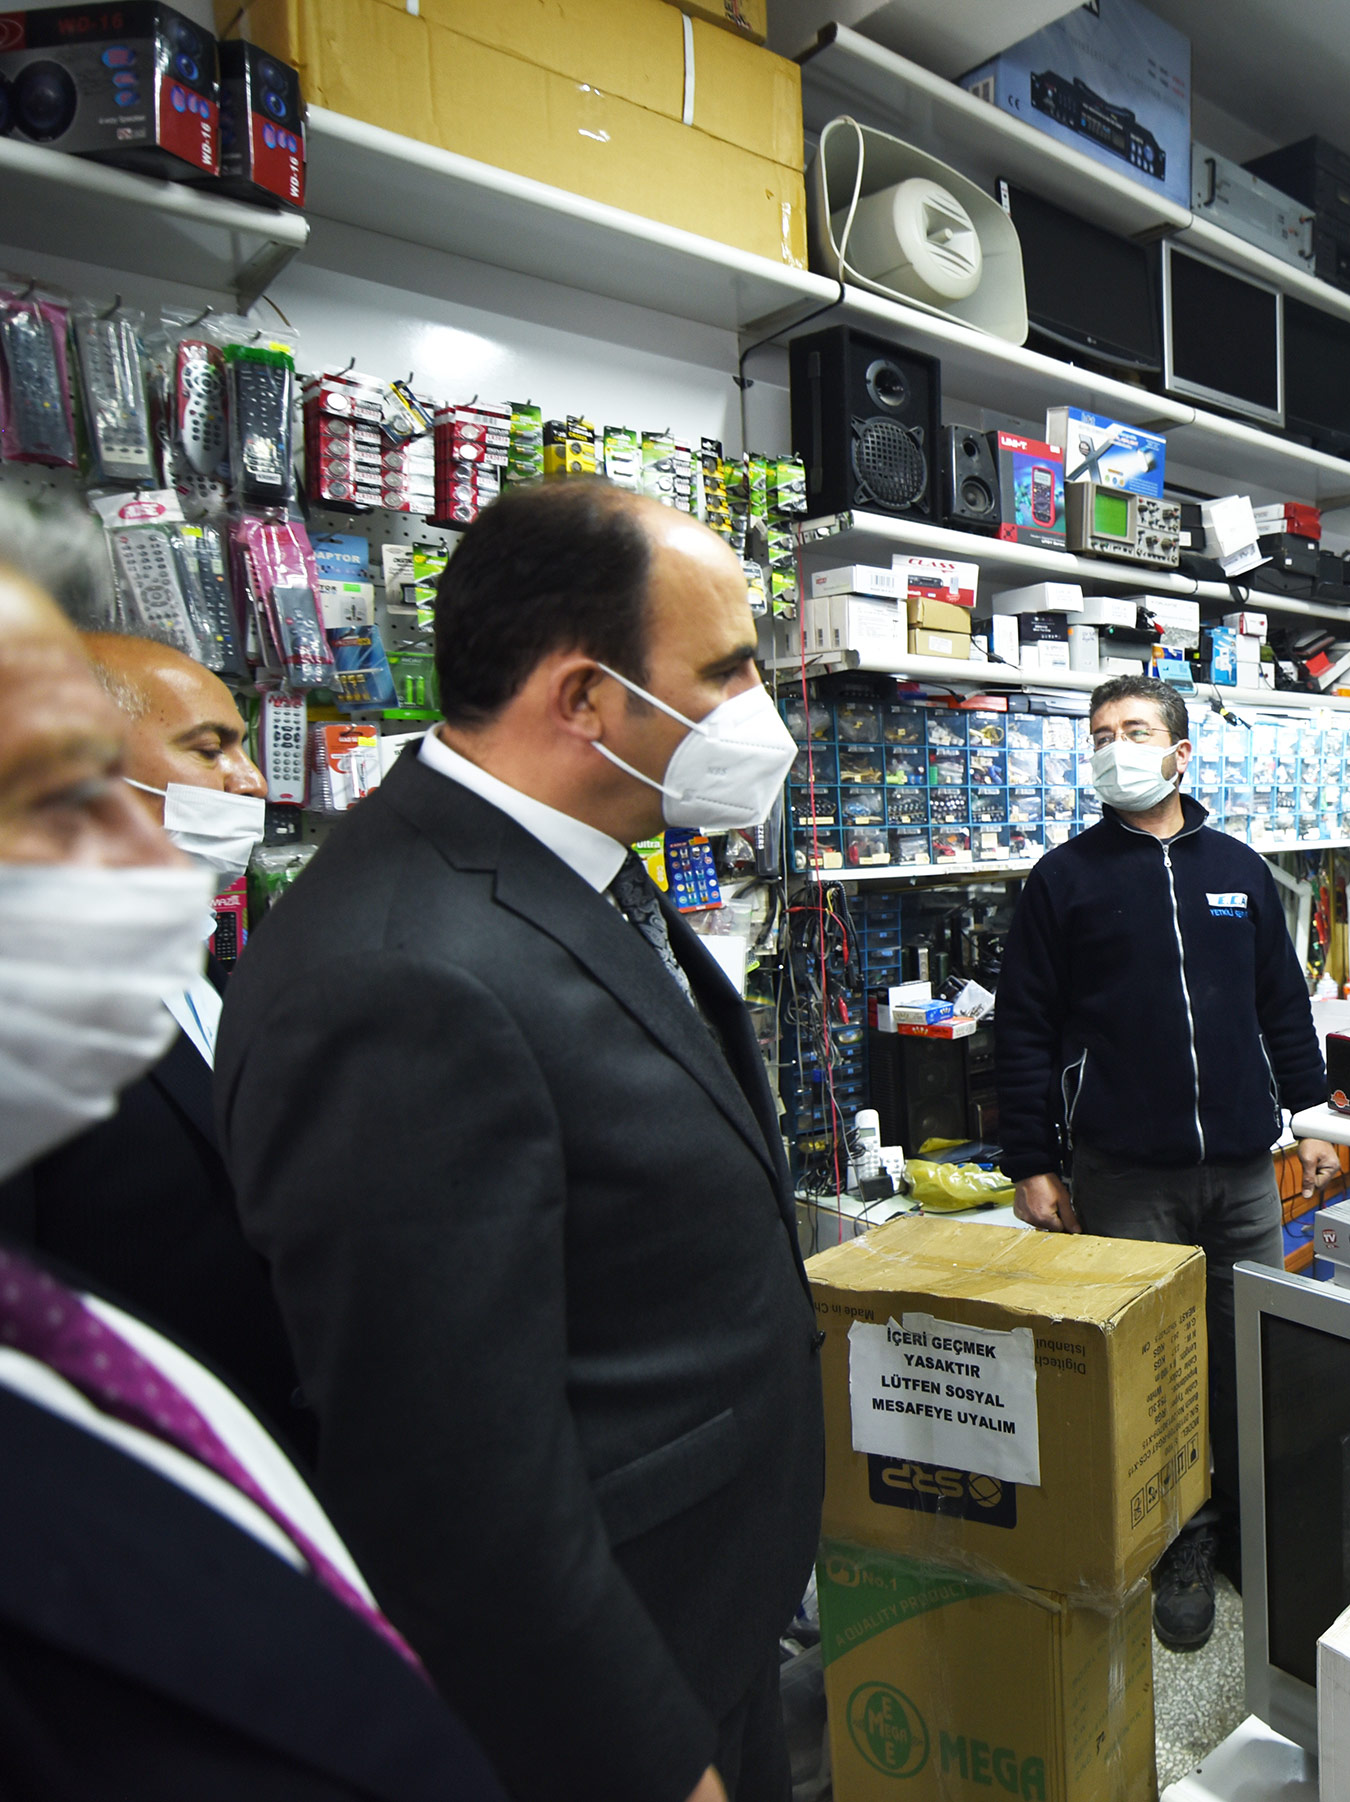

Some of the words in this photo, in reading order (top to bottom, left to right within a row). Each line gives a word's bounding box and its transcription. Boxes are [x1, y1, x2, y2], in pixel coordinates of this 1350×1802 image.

[201, 122, 213, 166] WD-16
[289, 155, 300, 198] WD-16
[908, 557, 956, 571] CLASS
[1323, 1233, 1336, 1243] TV
[844, 1305, 875, 1321] Made
[887, 1327, 928, 1347] İÇERİ
[931, 1334, 997, 1360] GEÇMEK
[903, 1353, 981, 1380] YASAKTIR
[1035, 1353, 1087, 1376] Digitech
[881, 1374, 941, 1396] LÜTFEN
[945, 1383, 1005, 1409] SOSYAL
[871, 1397, 953, 1422] MESAFEYE
[957, 1410, 1016, 1436] UYALIM
[862, 1570, 898, 1591] No.1
[844, 1601, 898, 1641] QUALITY
[901, 1581, 967, 1614] PRODUCT
[938, 1729, 1047, 1802] MEGA
